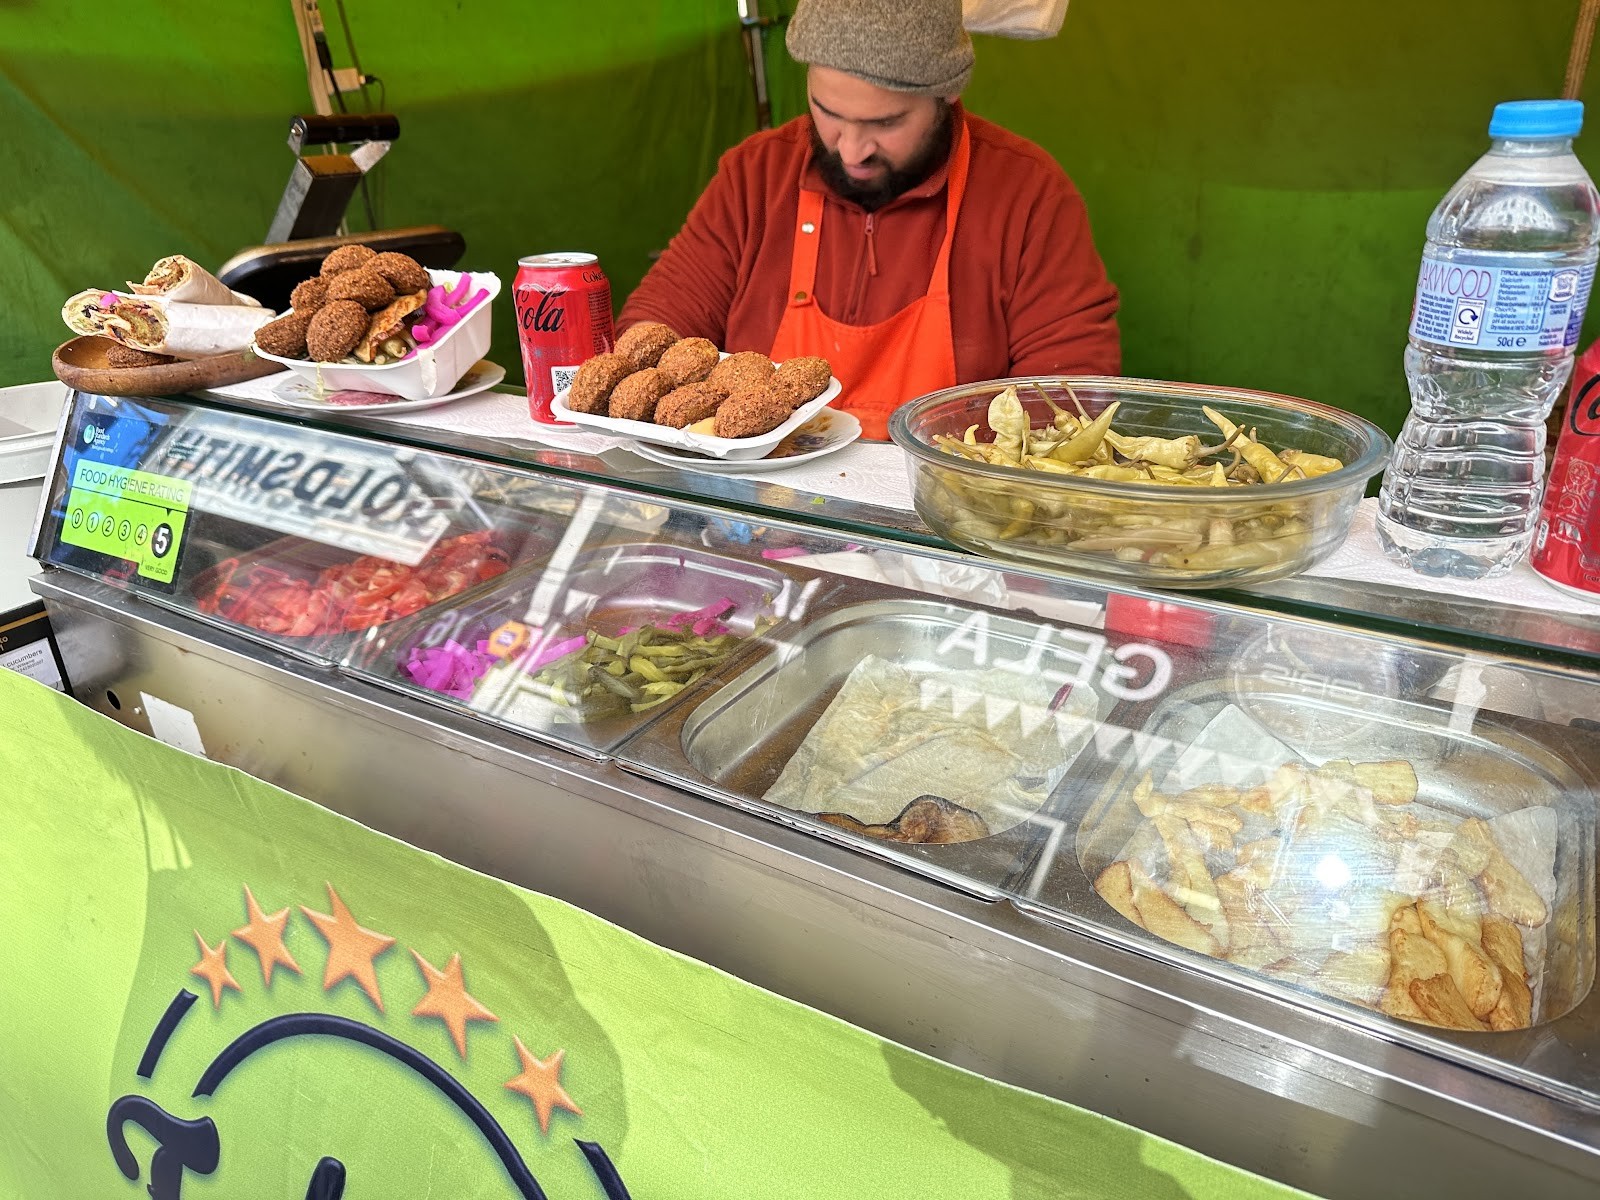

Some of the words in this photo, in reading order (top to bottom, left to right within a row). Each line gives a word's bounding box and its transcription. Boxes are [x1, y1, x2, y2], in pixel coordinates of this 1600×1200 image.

[80, 468, 107, 485] FOOD
[108, 475, 148, 493] HYGIENE
[149, 482, 184, 502] RATING
[155, 527, 169, 555] 5
[6, 650, 43, 668] cucumbers
